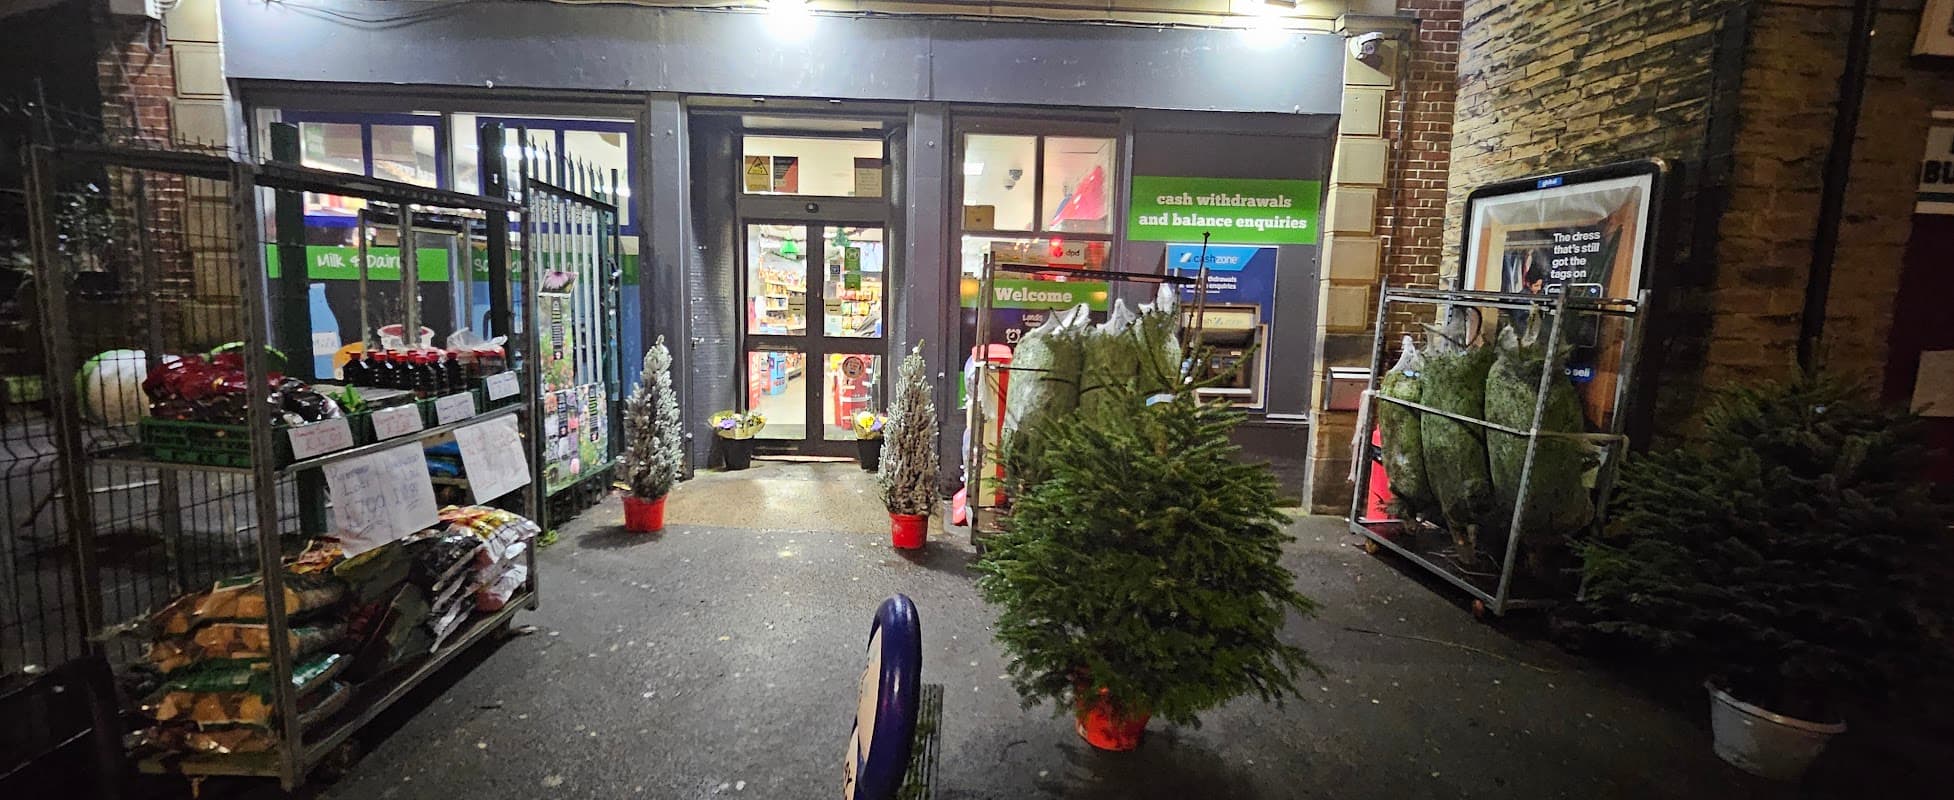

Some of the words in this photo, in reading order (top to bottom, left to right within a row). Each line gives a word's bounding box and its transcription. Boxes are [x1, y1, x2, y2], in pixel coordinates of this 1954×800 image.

[1156, 192, 1193, 206] cash
[1196, 193, 1292, 208] withdrawals
[1138, 213, 1169, 226] and
[1172, 213, 1233, 227] balance
[1235, 216, 1307, 231] enquiries
[1553, 232, 1570, 242] The
[1572, 231, 1601, 241] dress
[1066, 247, 1080, 258] dpd
[1553, 244, 1580, 254] that's
[1581, 242, 1600, 253] still
[317, 253, 345, 268] Milk
[366, 254, 401, 269] Dair
[1193, 253, 1238, 265] cshzone
[1552, 258, 1568, 268] got
[1570, 256, 1587, 266] the
[1550, 270, 1573, 281] tags
[1573, 270, 1587, 278] on
[994, 287, 1073, 303] Welcome
[1572, 367, 1591, 377] sell
